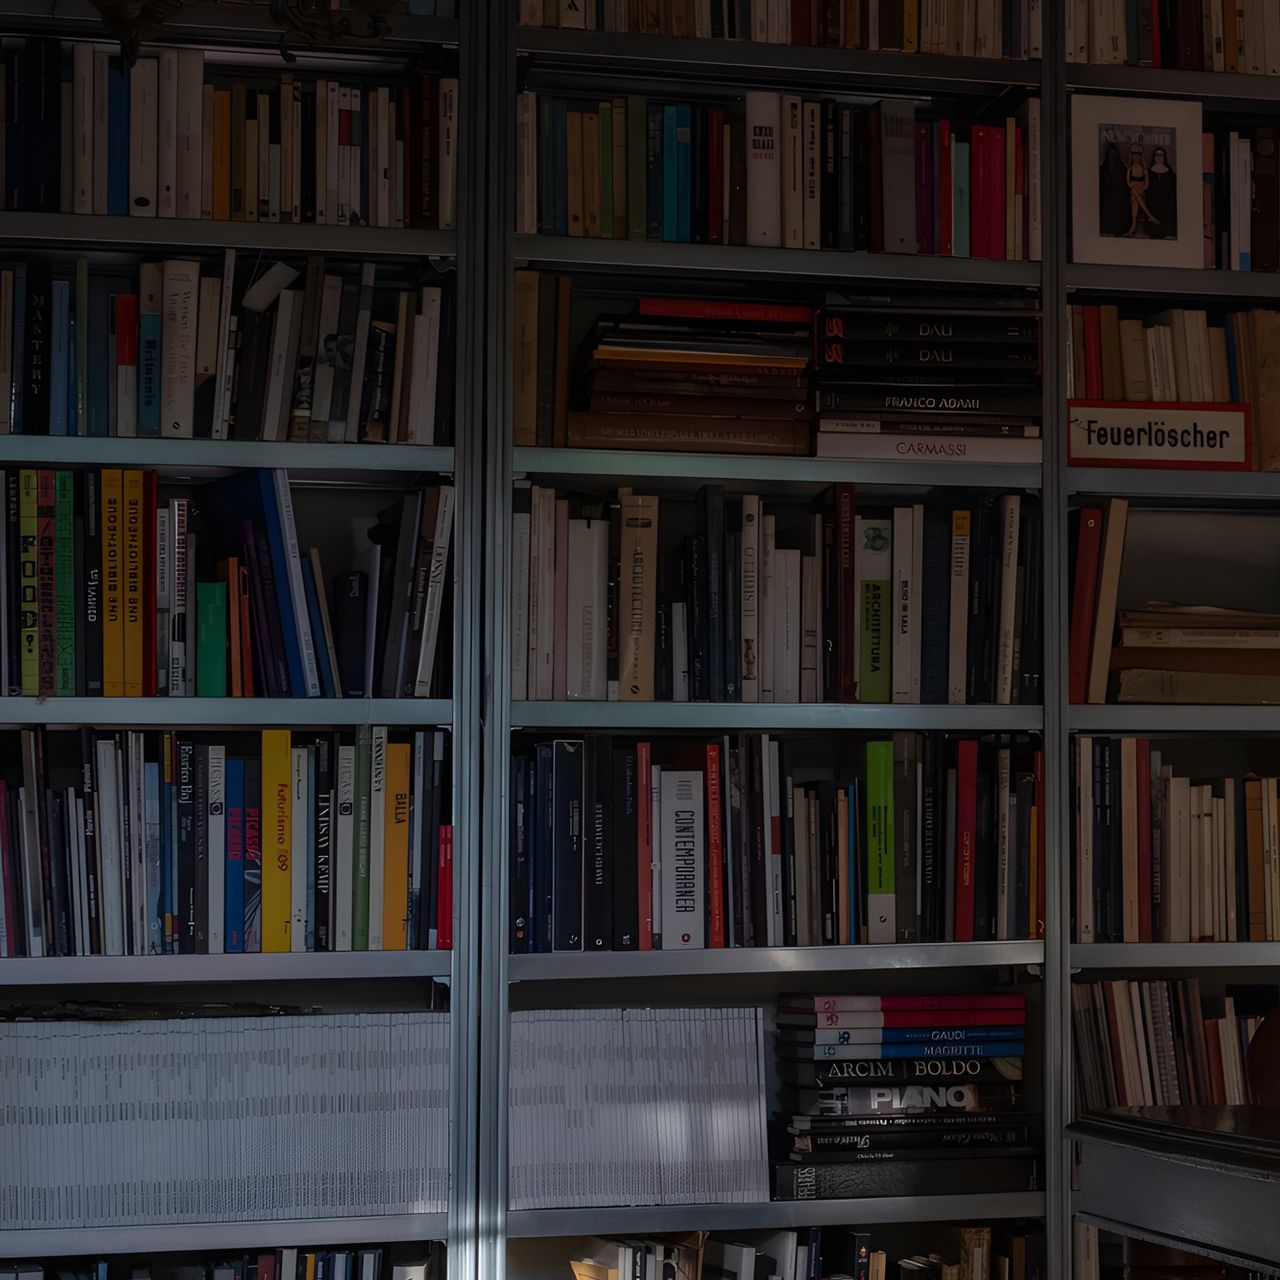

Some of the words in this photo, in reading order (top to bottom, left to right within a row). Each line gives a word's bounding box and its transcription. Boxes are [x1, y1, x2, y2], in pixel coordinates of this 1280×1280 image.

[896, 441, 967, 457] CARMASSI
[1086, 419, 1231, 449] Feuerlöscher
[870, 583, 882, 673] ARCHITETTURA
[178, 745, 194, 784] Enrico
[277, 783, 289, 845] Futurismo
[318, 793, 330, 849] LINDSAY
[394, 793, 407, 824] BALLA
[317, 854, 329, 894] KEMP
[674, 809, 696, 913] CONTEMPORANEA
[828, 1059, 896, 1078] ARCIM
[915, 1058, 981, 1077] BOLDO
[870, 1084, 976, 1110] PIANO
